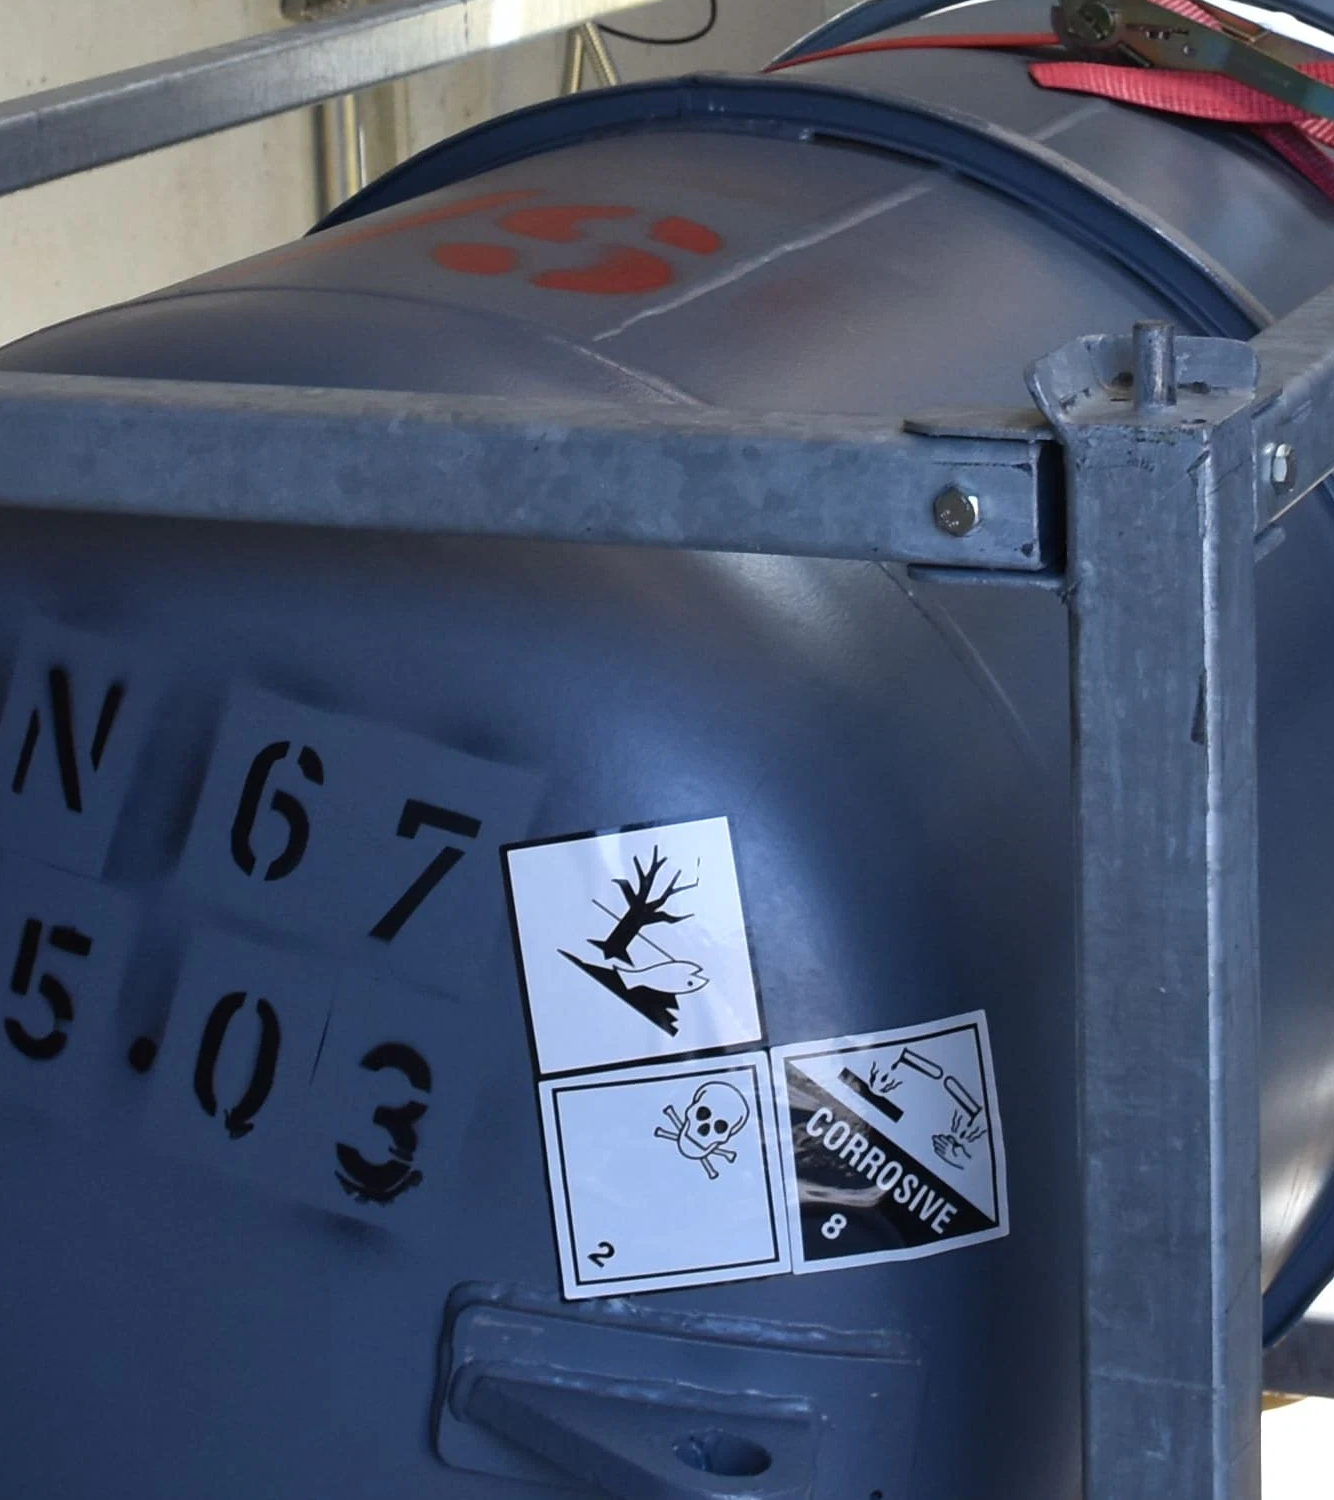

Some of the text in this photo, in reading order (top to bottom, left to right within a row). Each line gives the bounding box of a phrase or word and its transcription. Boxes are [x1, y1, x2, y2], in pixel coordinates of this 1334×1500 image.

[12, 666, 482, 943] N 67
[804, 1106, 959, 1236] CORROSIVE
[587, 1240, 616, 1269] 2
[820, 1212, 848, 1241] 8
